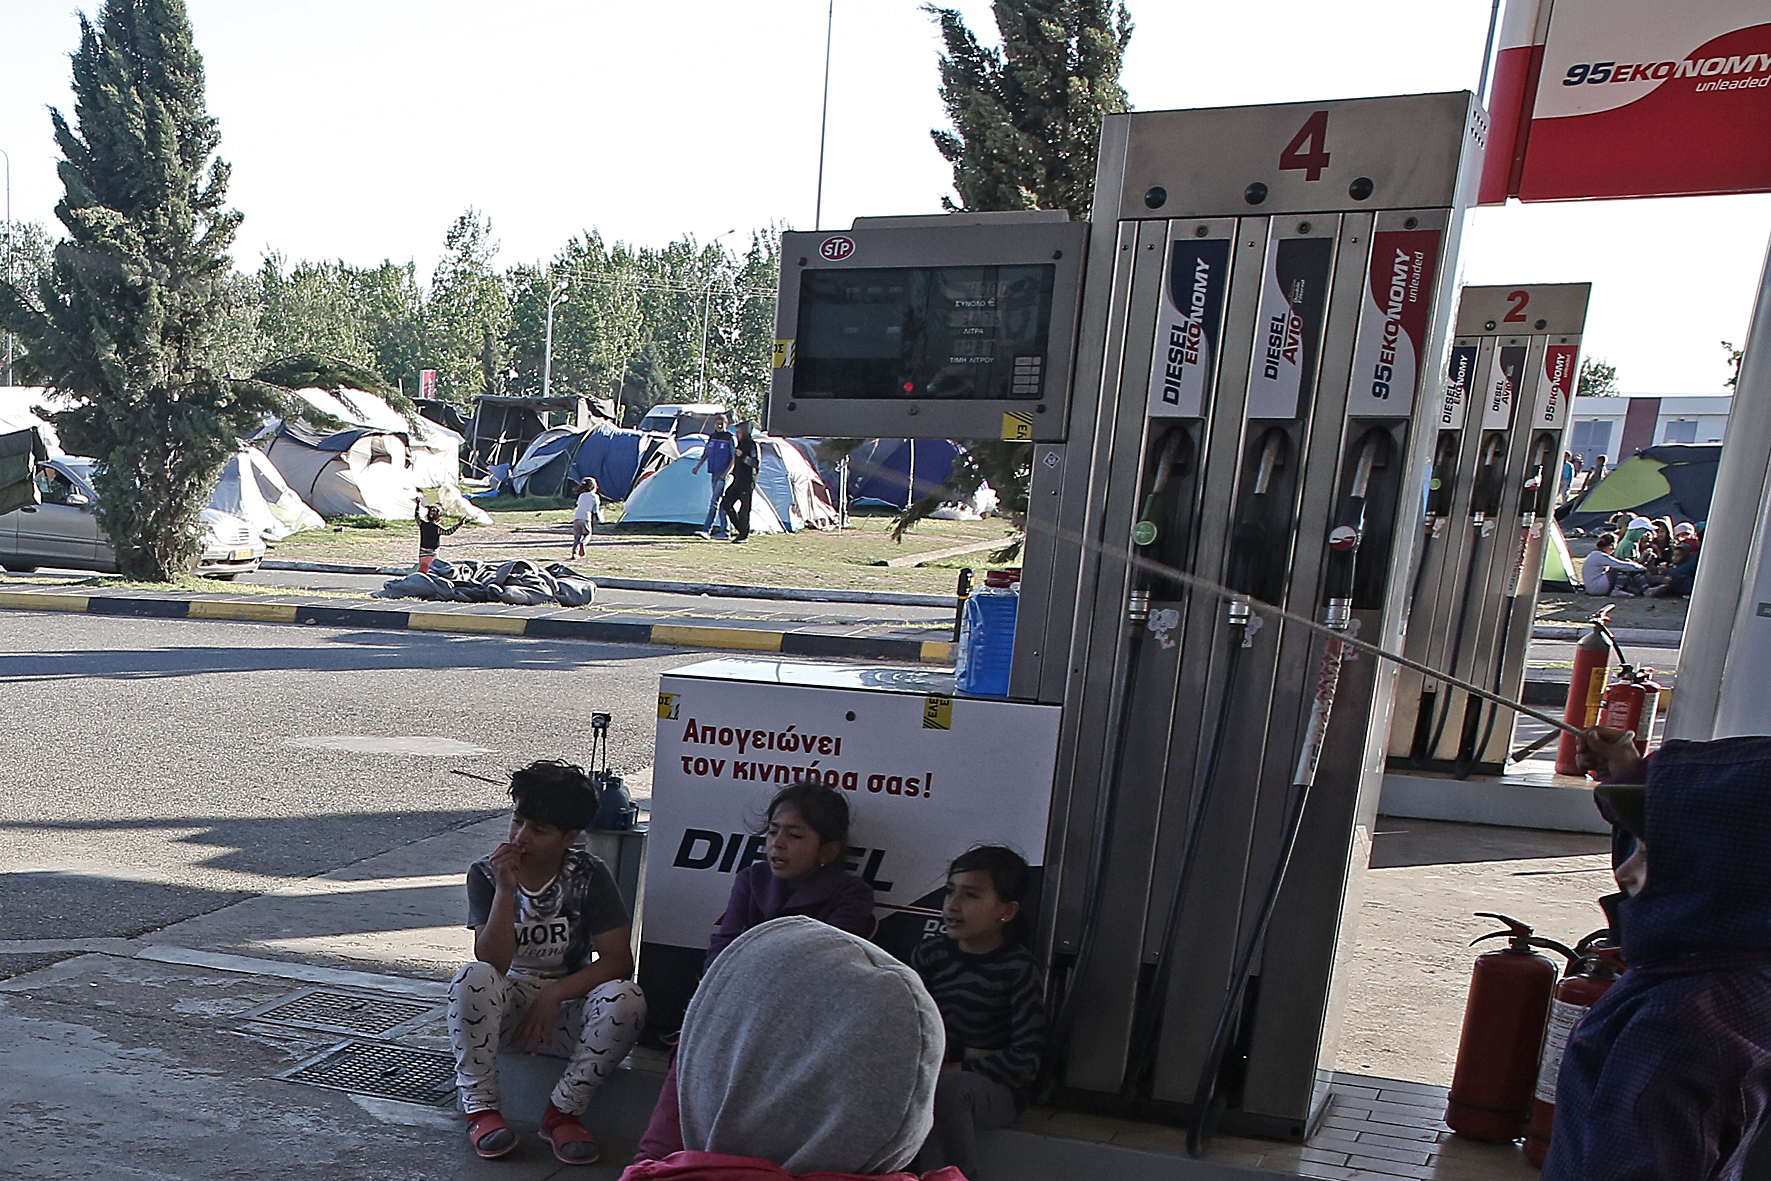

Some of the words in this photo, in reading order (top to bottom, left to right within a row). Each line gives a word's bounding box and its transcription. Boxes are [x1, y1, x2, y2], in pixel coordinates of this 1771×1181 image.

[1695, 75, 1771, 92] unleaded
[1278, 110, 1331, 182] 4
[1408, 251, 1424, 303] unleaded
[954, 300, 986, 308] ΣΥΝΟΛΟ
[1184, 257, 1211, 366] EKONOMY
[1371, 247, 1412, 401] 95EKONOMY
[1503, 290, 1530, 323] 2
[949, 356, 967, 364] ΤΙΜΗ
[968, 356, 995, 364] ΛΙΤΡΟΥ
[1162, 318, 1189, 407] DIESEL
[1264, 312, 1287, 380] DIESEL
[1281, 315, 1303, 366] AVIO
[1442, 382, 1458, 424] DIESEL
[1492, 380, 1505, 412] DIESEL
[1544, 352, 1566, 422] 95EKONOMY
[681, 717, 842, 756] Απογειώνει
[680, 755, 726, 778] τον
[732, 759, 859, 791] κινητήρα
[866, 772, 933, 799] σας!
